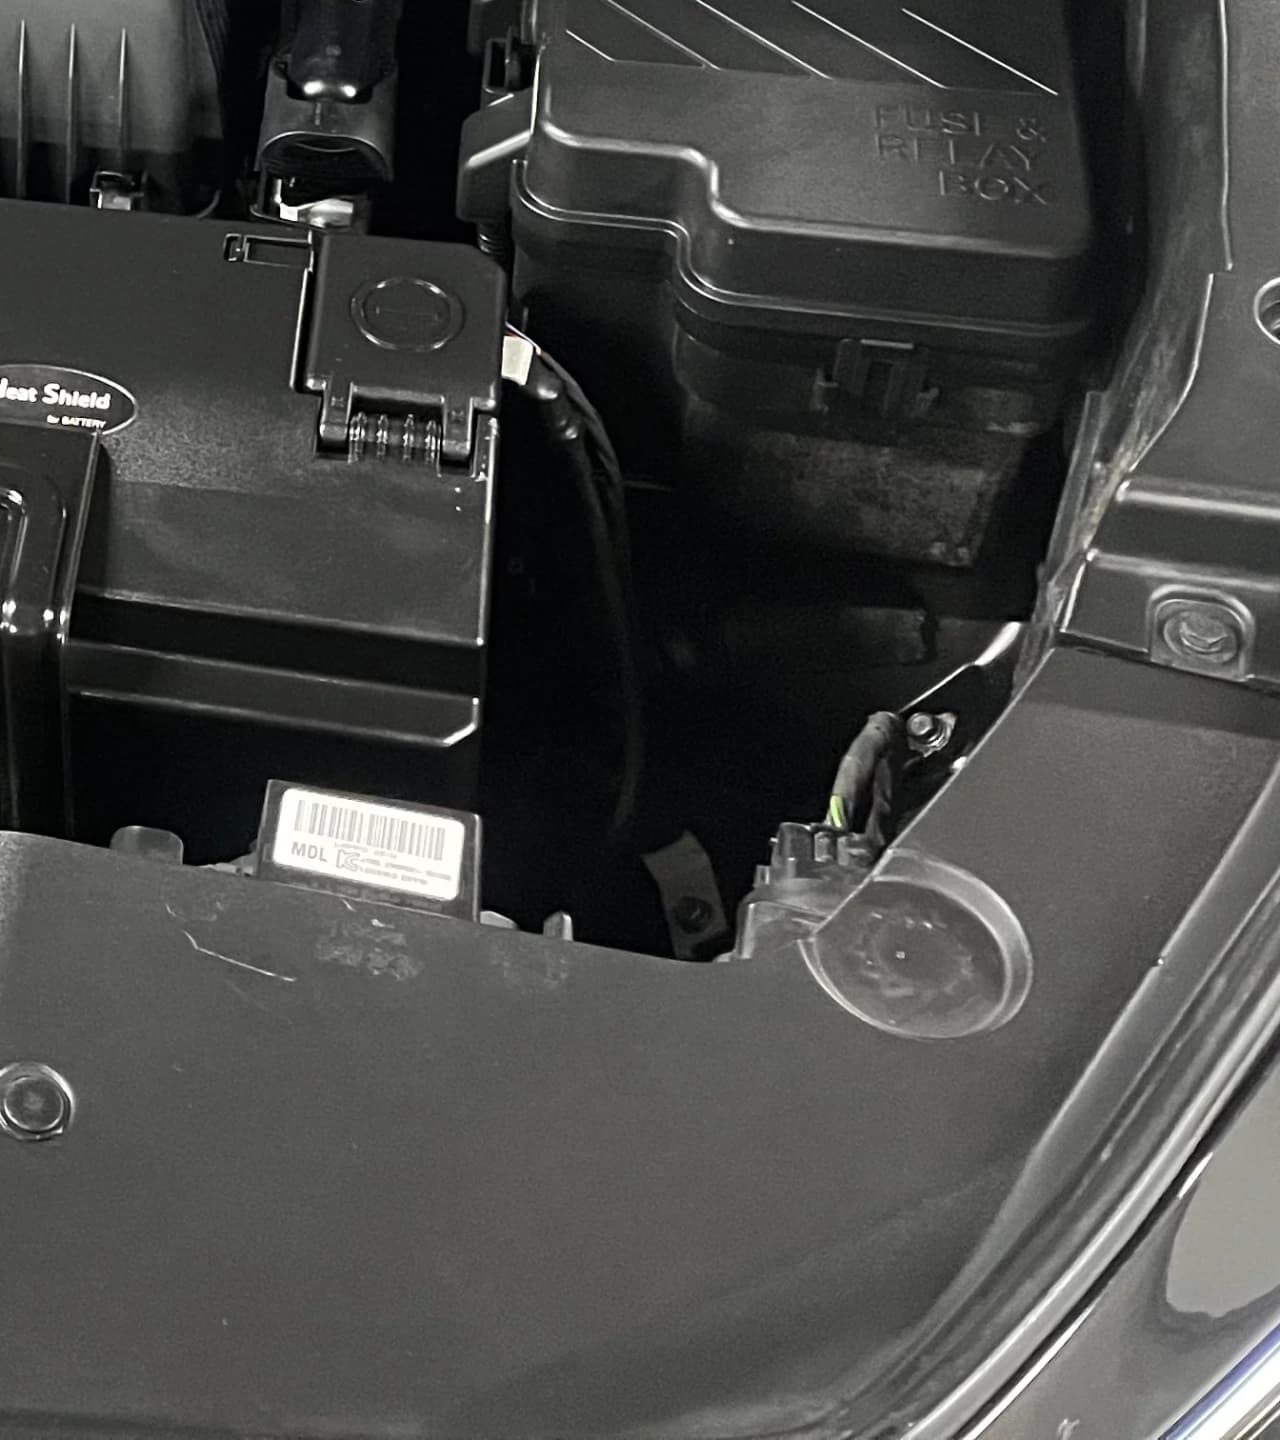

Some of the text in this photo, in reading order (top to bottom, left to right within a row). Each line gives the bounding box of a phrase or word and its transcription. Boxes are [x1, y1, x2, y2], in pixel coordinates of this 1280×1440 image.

[41, 383, 112, 410] Shield
[61, 415, 107, 430] BATTERY
[290, 841, 328, 863] MDL
